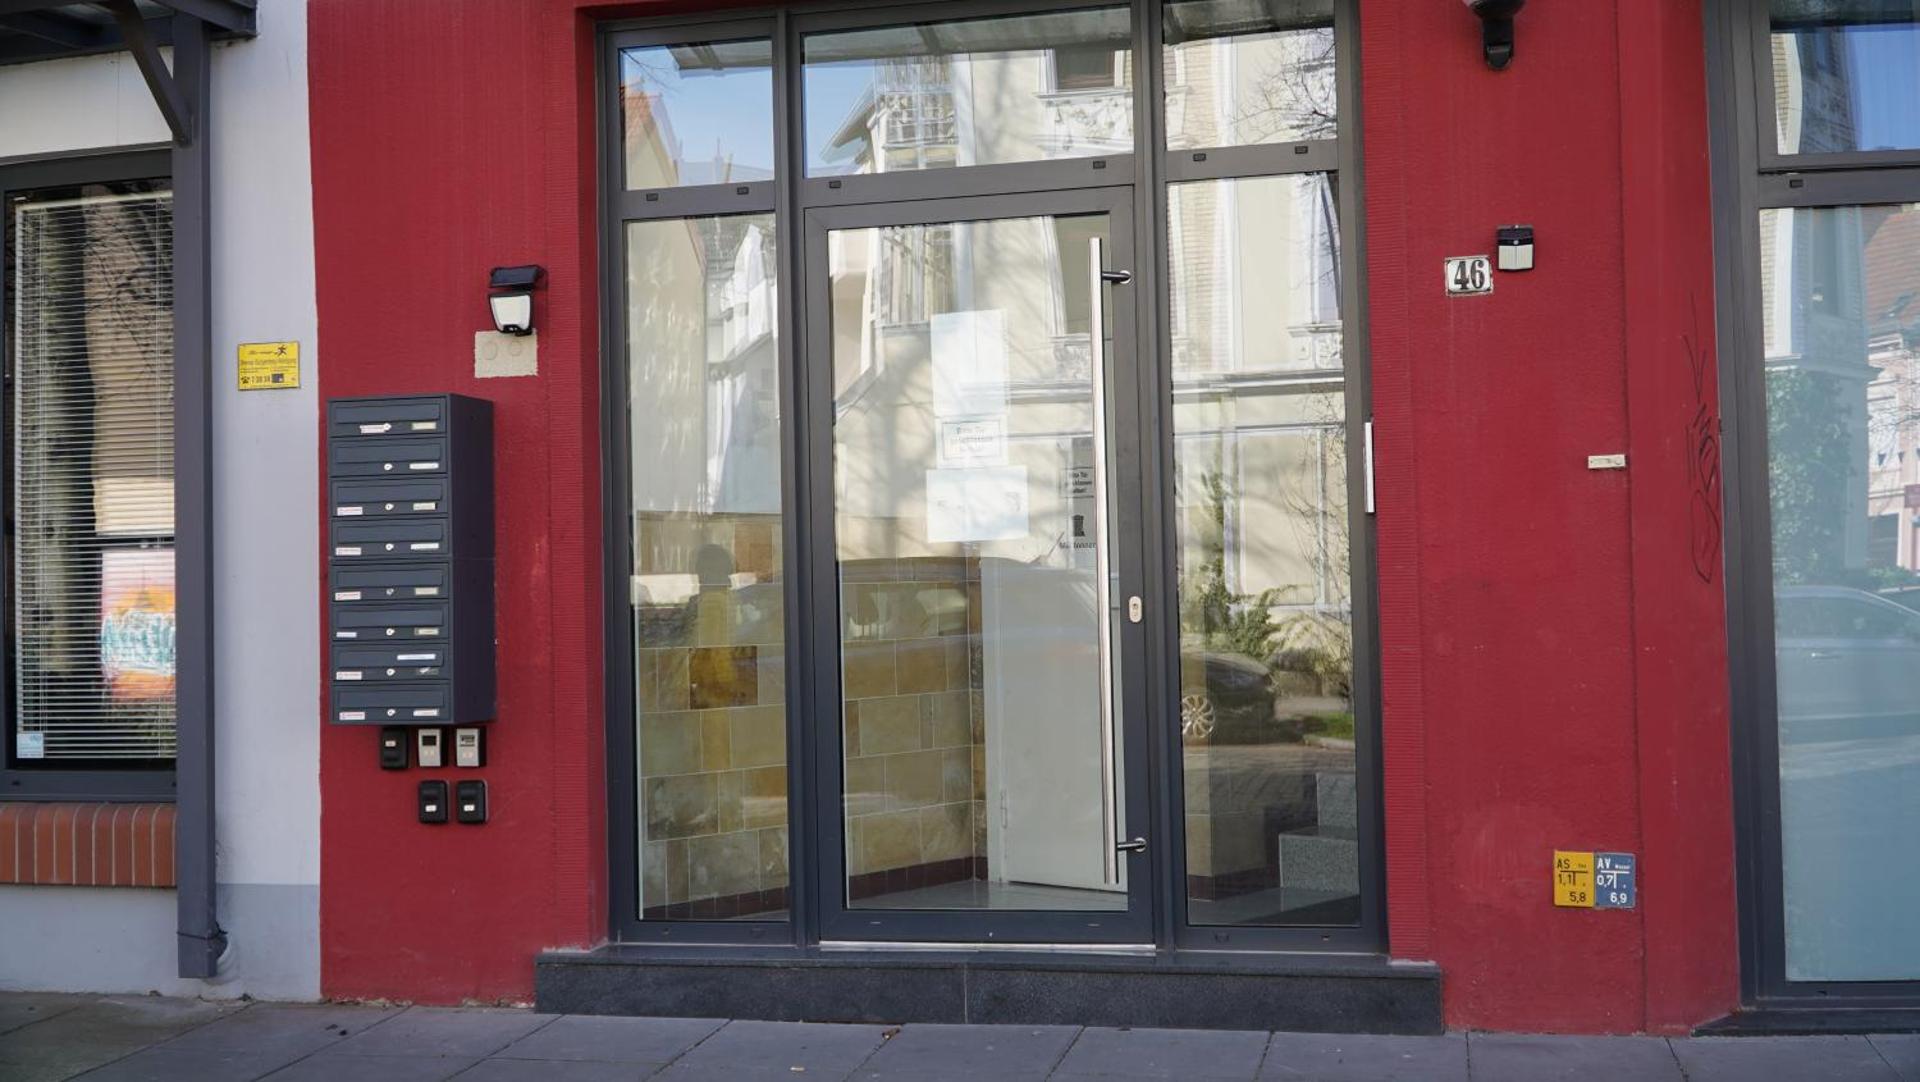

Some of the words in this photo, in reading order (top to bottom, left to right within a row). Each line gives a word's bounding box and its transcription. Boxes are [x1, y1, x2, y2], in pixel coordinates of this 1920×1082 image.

[1454, 259, 1485, 290] 46
[1557, 859, 1570, 869] AS
[1597, 858, 1610, 869] AV
[1558, 874, 1571, 886] 1,1
[1597, 875, 1614, 888] 0,7
[1569, 892, 1586, 904] 5,8
[1610, 892, 1627, 905] 6,9
